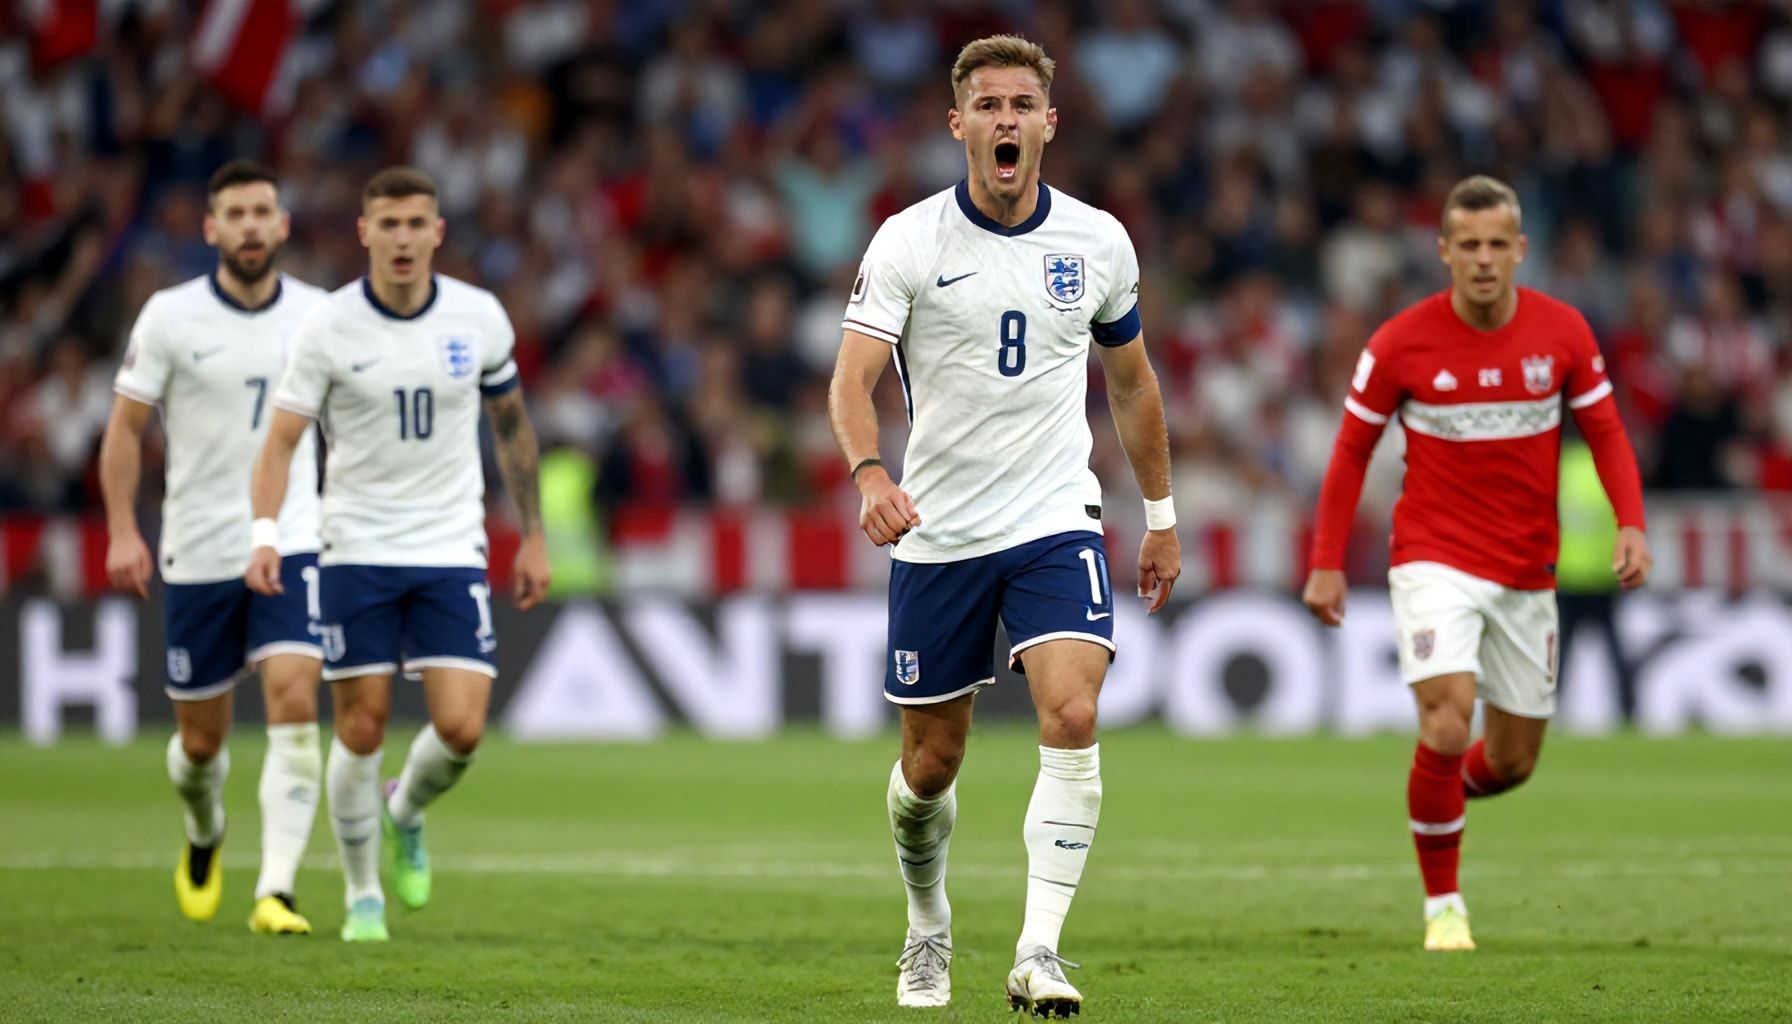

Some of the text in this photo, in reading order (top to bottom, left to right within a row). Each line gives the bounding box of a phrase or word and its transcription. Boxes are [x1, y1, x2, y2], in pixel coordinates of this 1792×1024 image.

[998, 310, 1027, 377] 8
[245, 377, 267, 431] 7
[394, 387, 434, 441] 10
